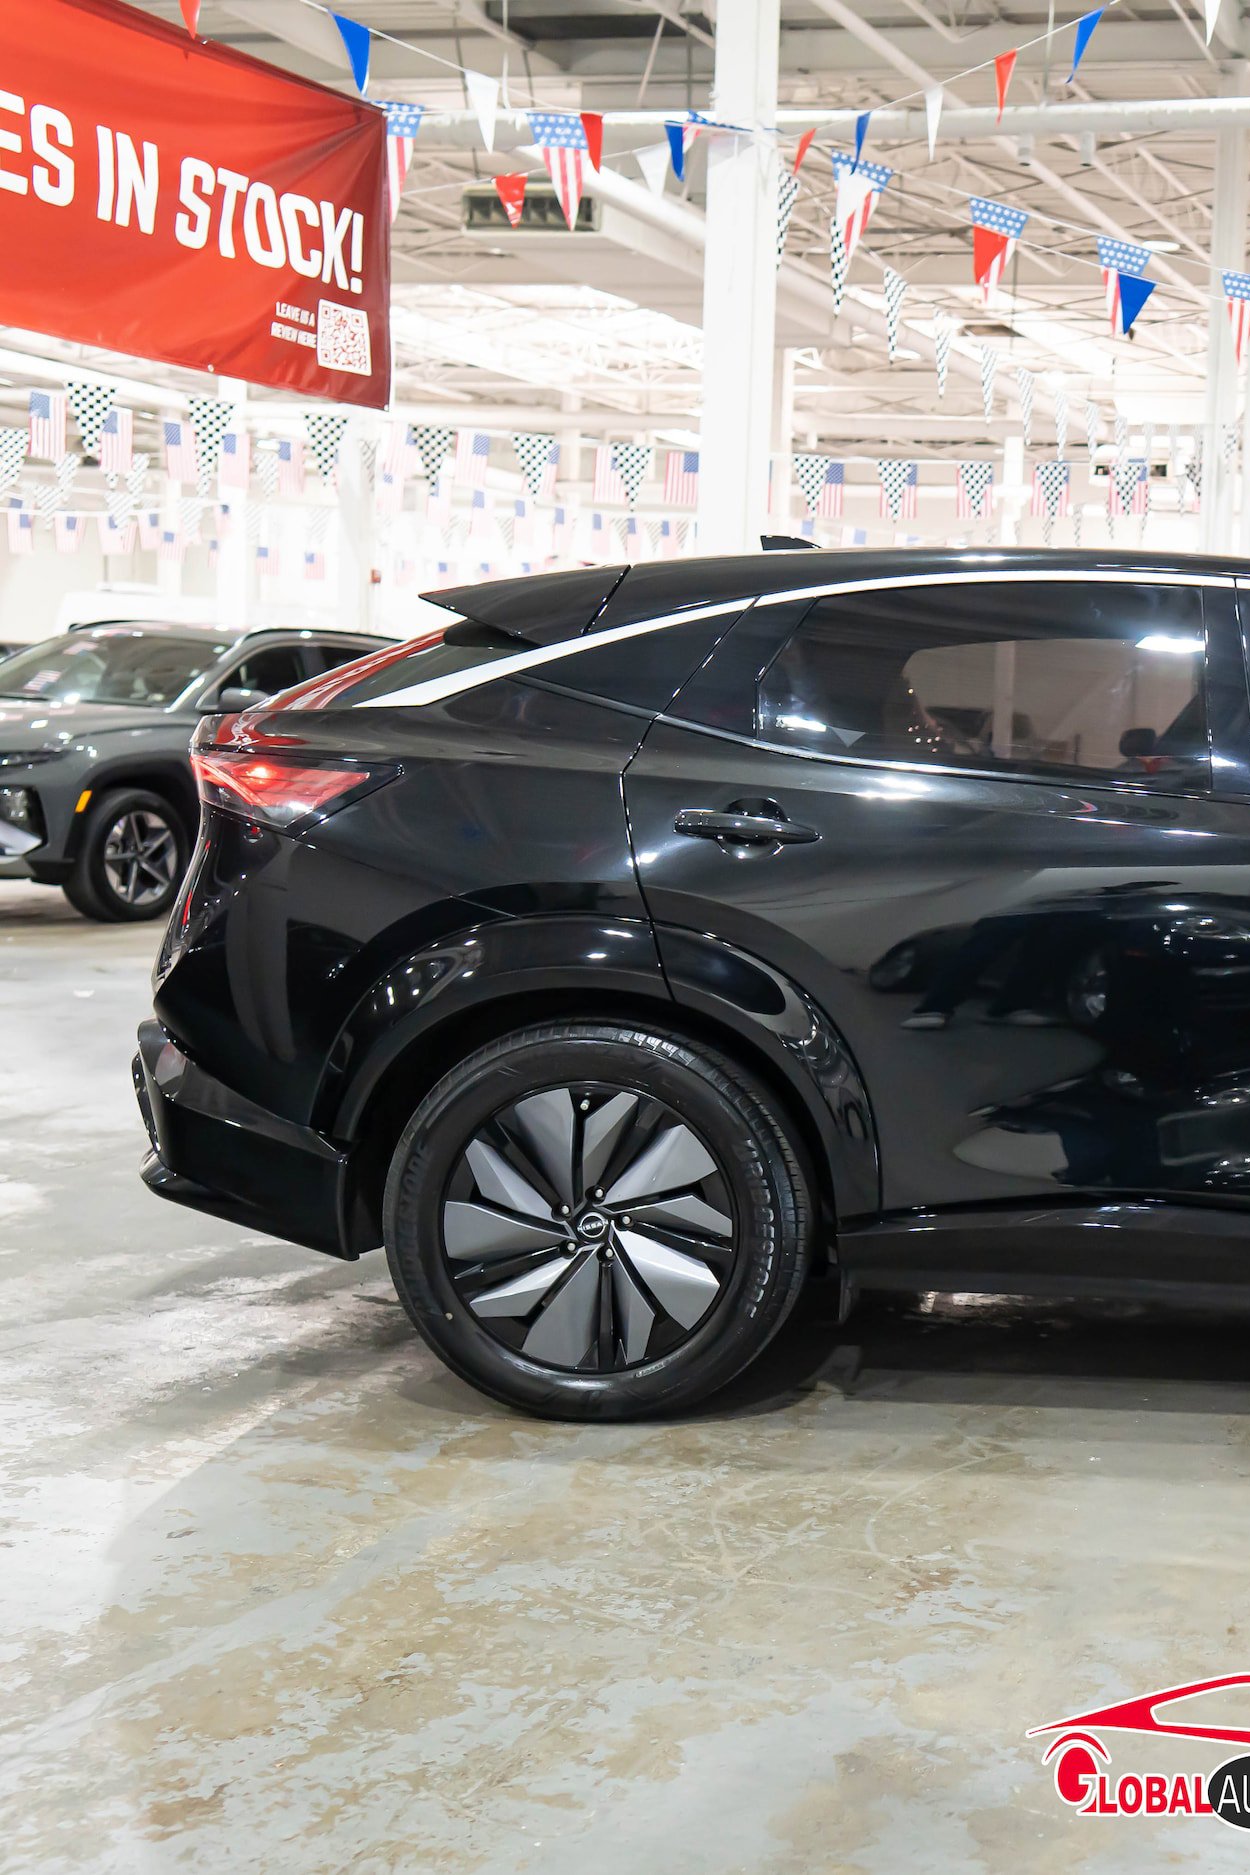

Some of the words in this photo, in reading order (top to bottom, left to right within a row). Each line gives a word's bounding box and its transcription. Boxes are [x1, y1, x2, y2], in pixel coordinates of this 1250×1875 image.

[97, 125, 159, 235] IN
[174, 157, 364, 294] STOCK!
[577, 1219, 609, 1232] NISSAN
